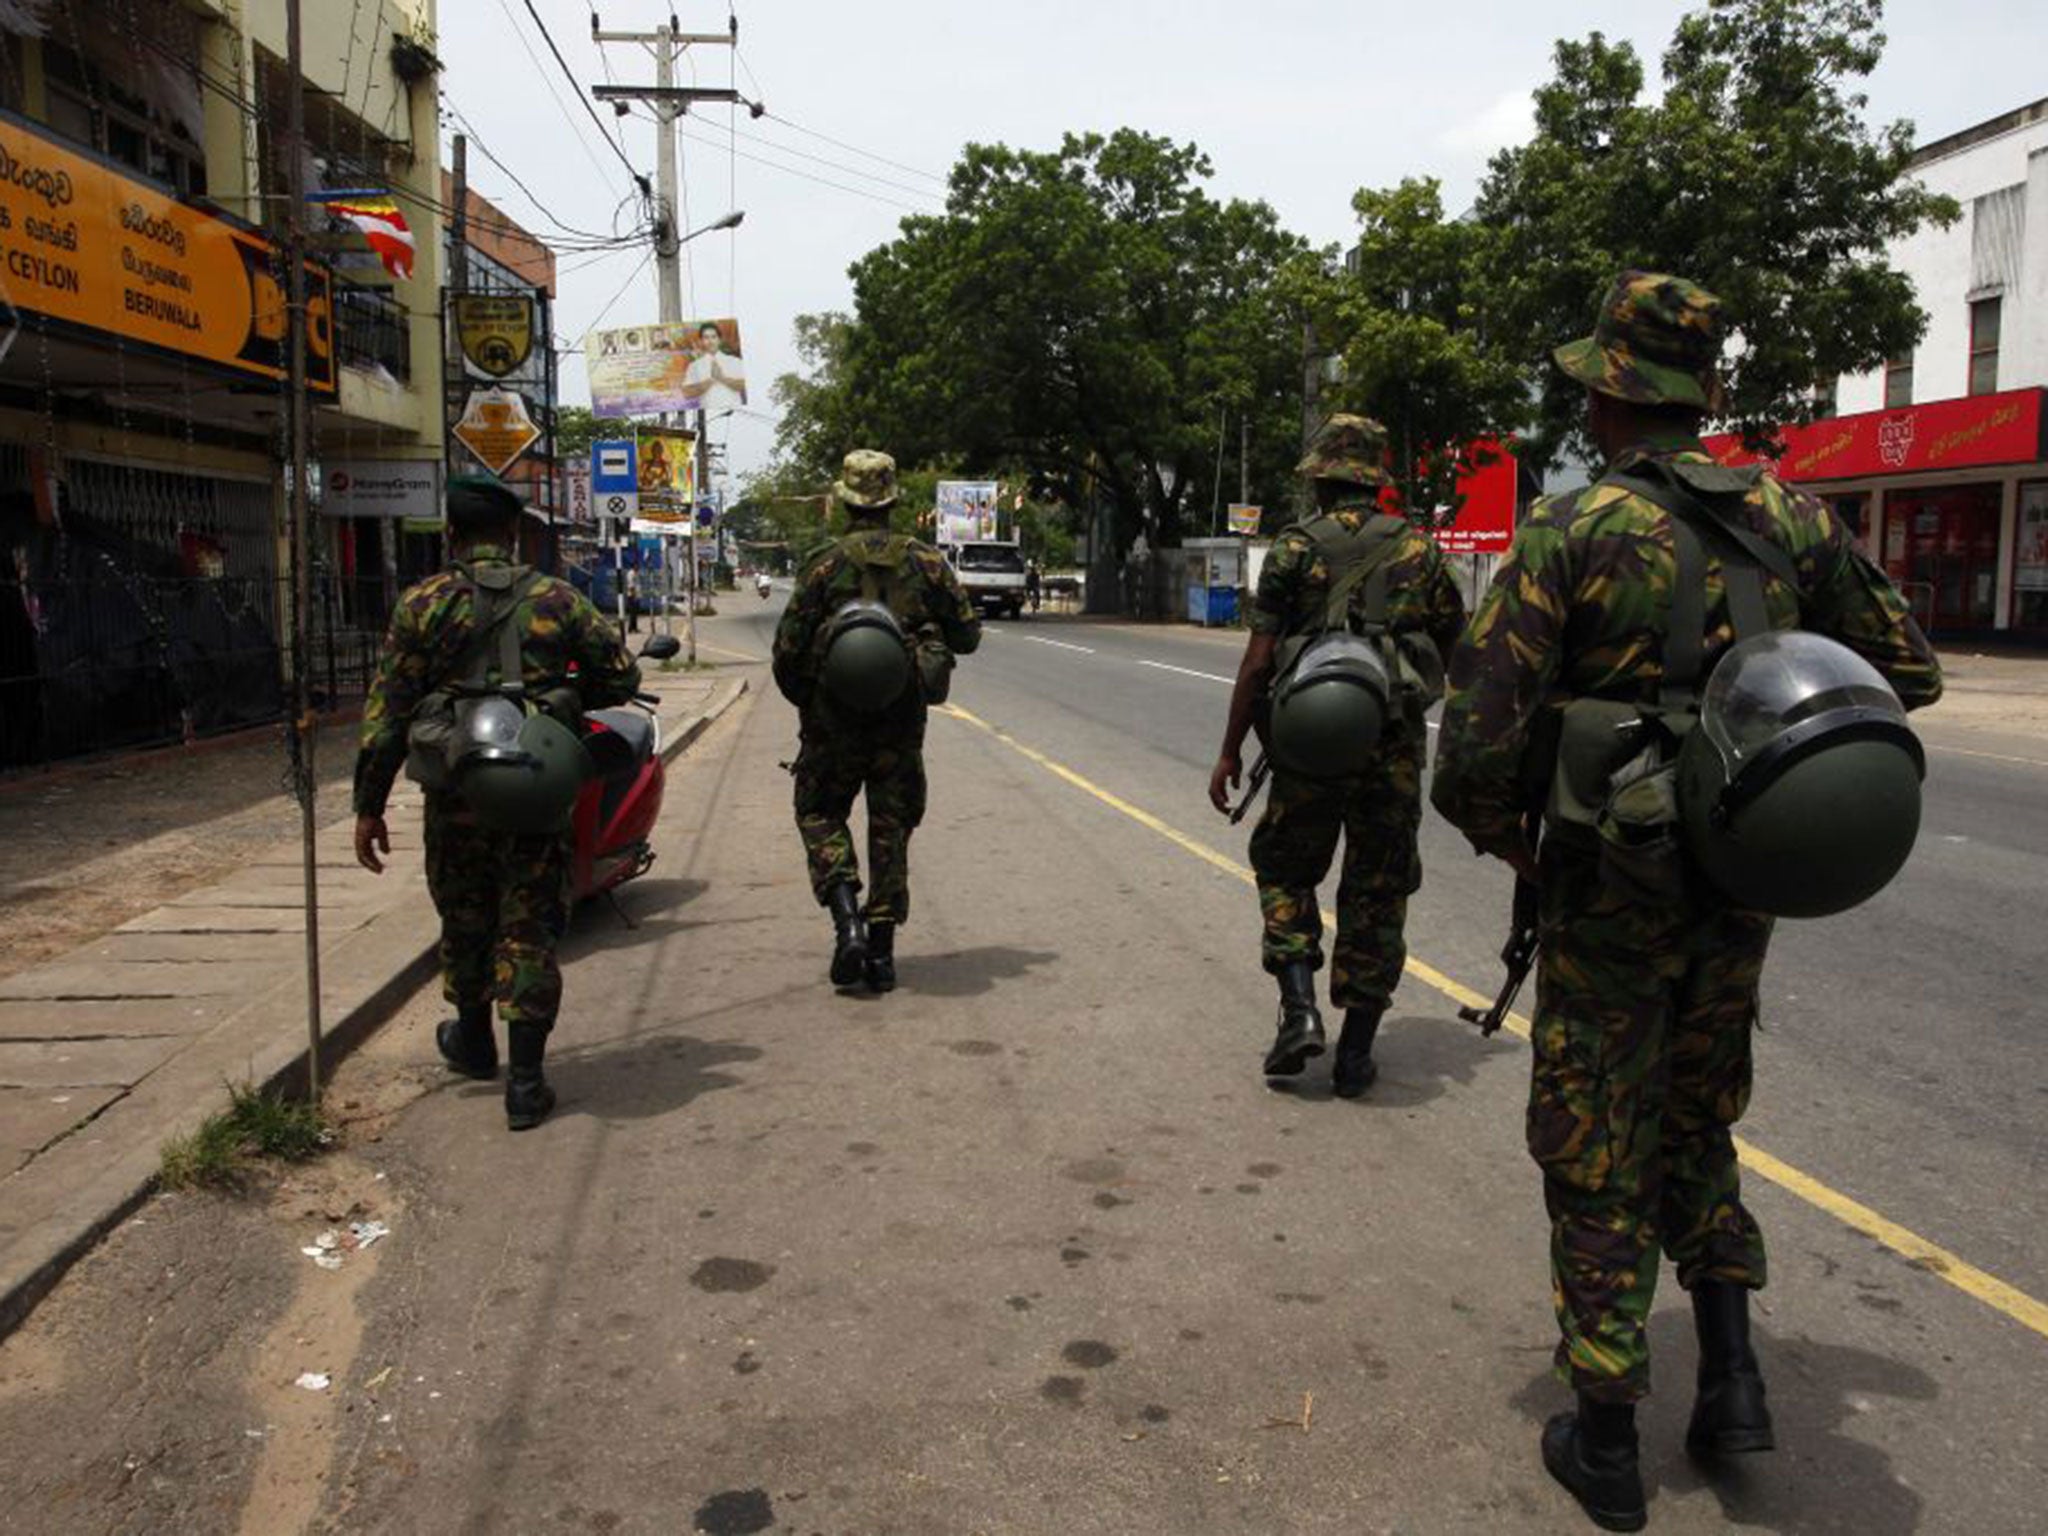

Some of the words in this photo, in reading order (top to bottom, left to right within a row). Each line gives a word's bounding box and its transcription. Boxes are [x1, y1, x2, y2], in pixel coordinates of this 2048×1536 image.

[8, 249, 79, 294] CEYLON
[124, 287, 202, 333] BERUWALA
[352, 477, 432, 493] MoneyGram
